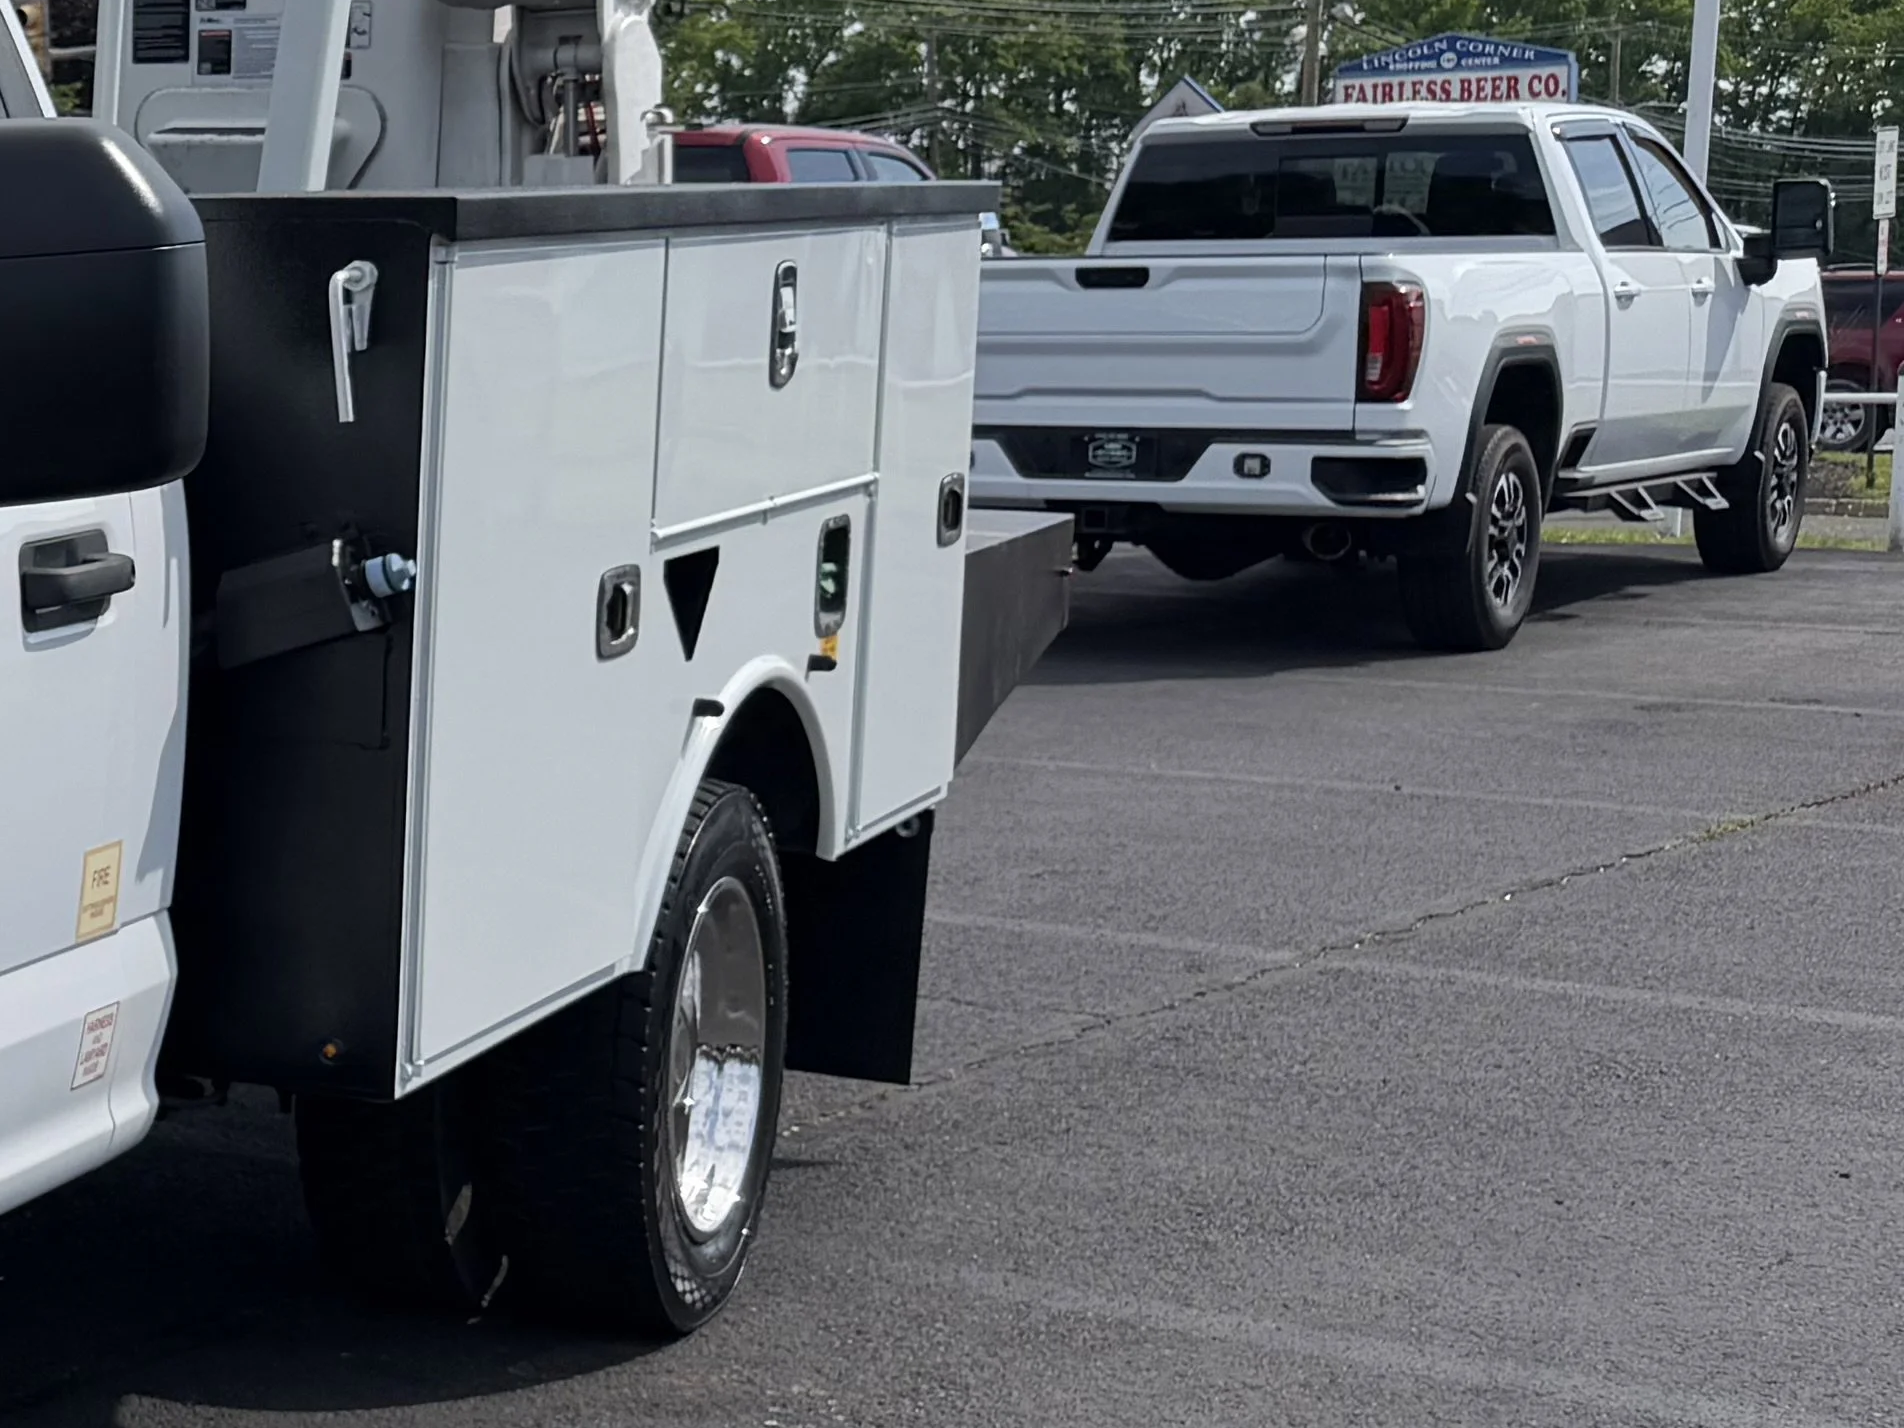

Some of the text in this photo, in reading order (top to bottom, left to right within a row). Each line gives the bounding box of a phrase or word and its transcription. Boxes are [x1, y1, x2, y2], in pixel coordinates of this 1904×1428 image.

[1361, 38, 1449, 71] LINCOLN
[1456, 39, 1535, 61] CORNER
[1343, 73, 1567, 104] FAIRLESS BEER CO.
